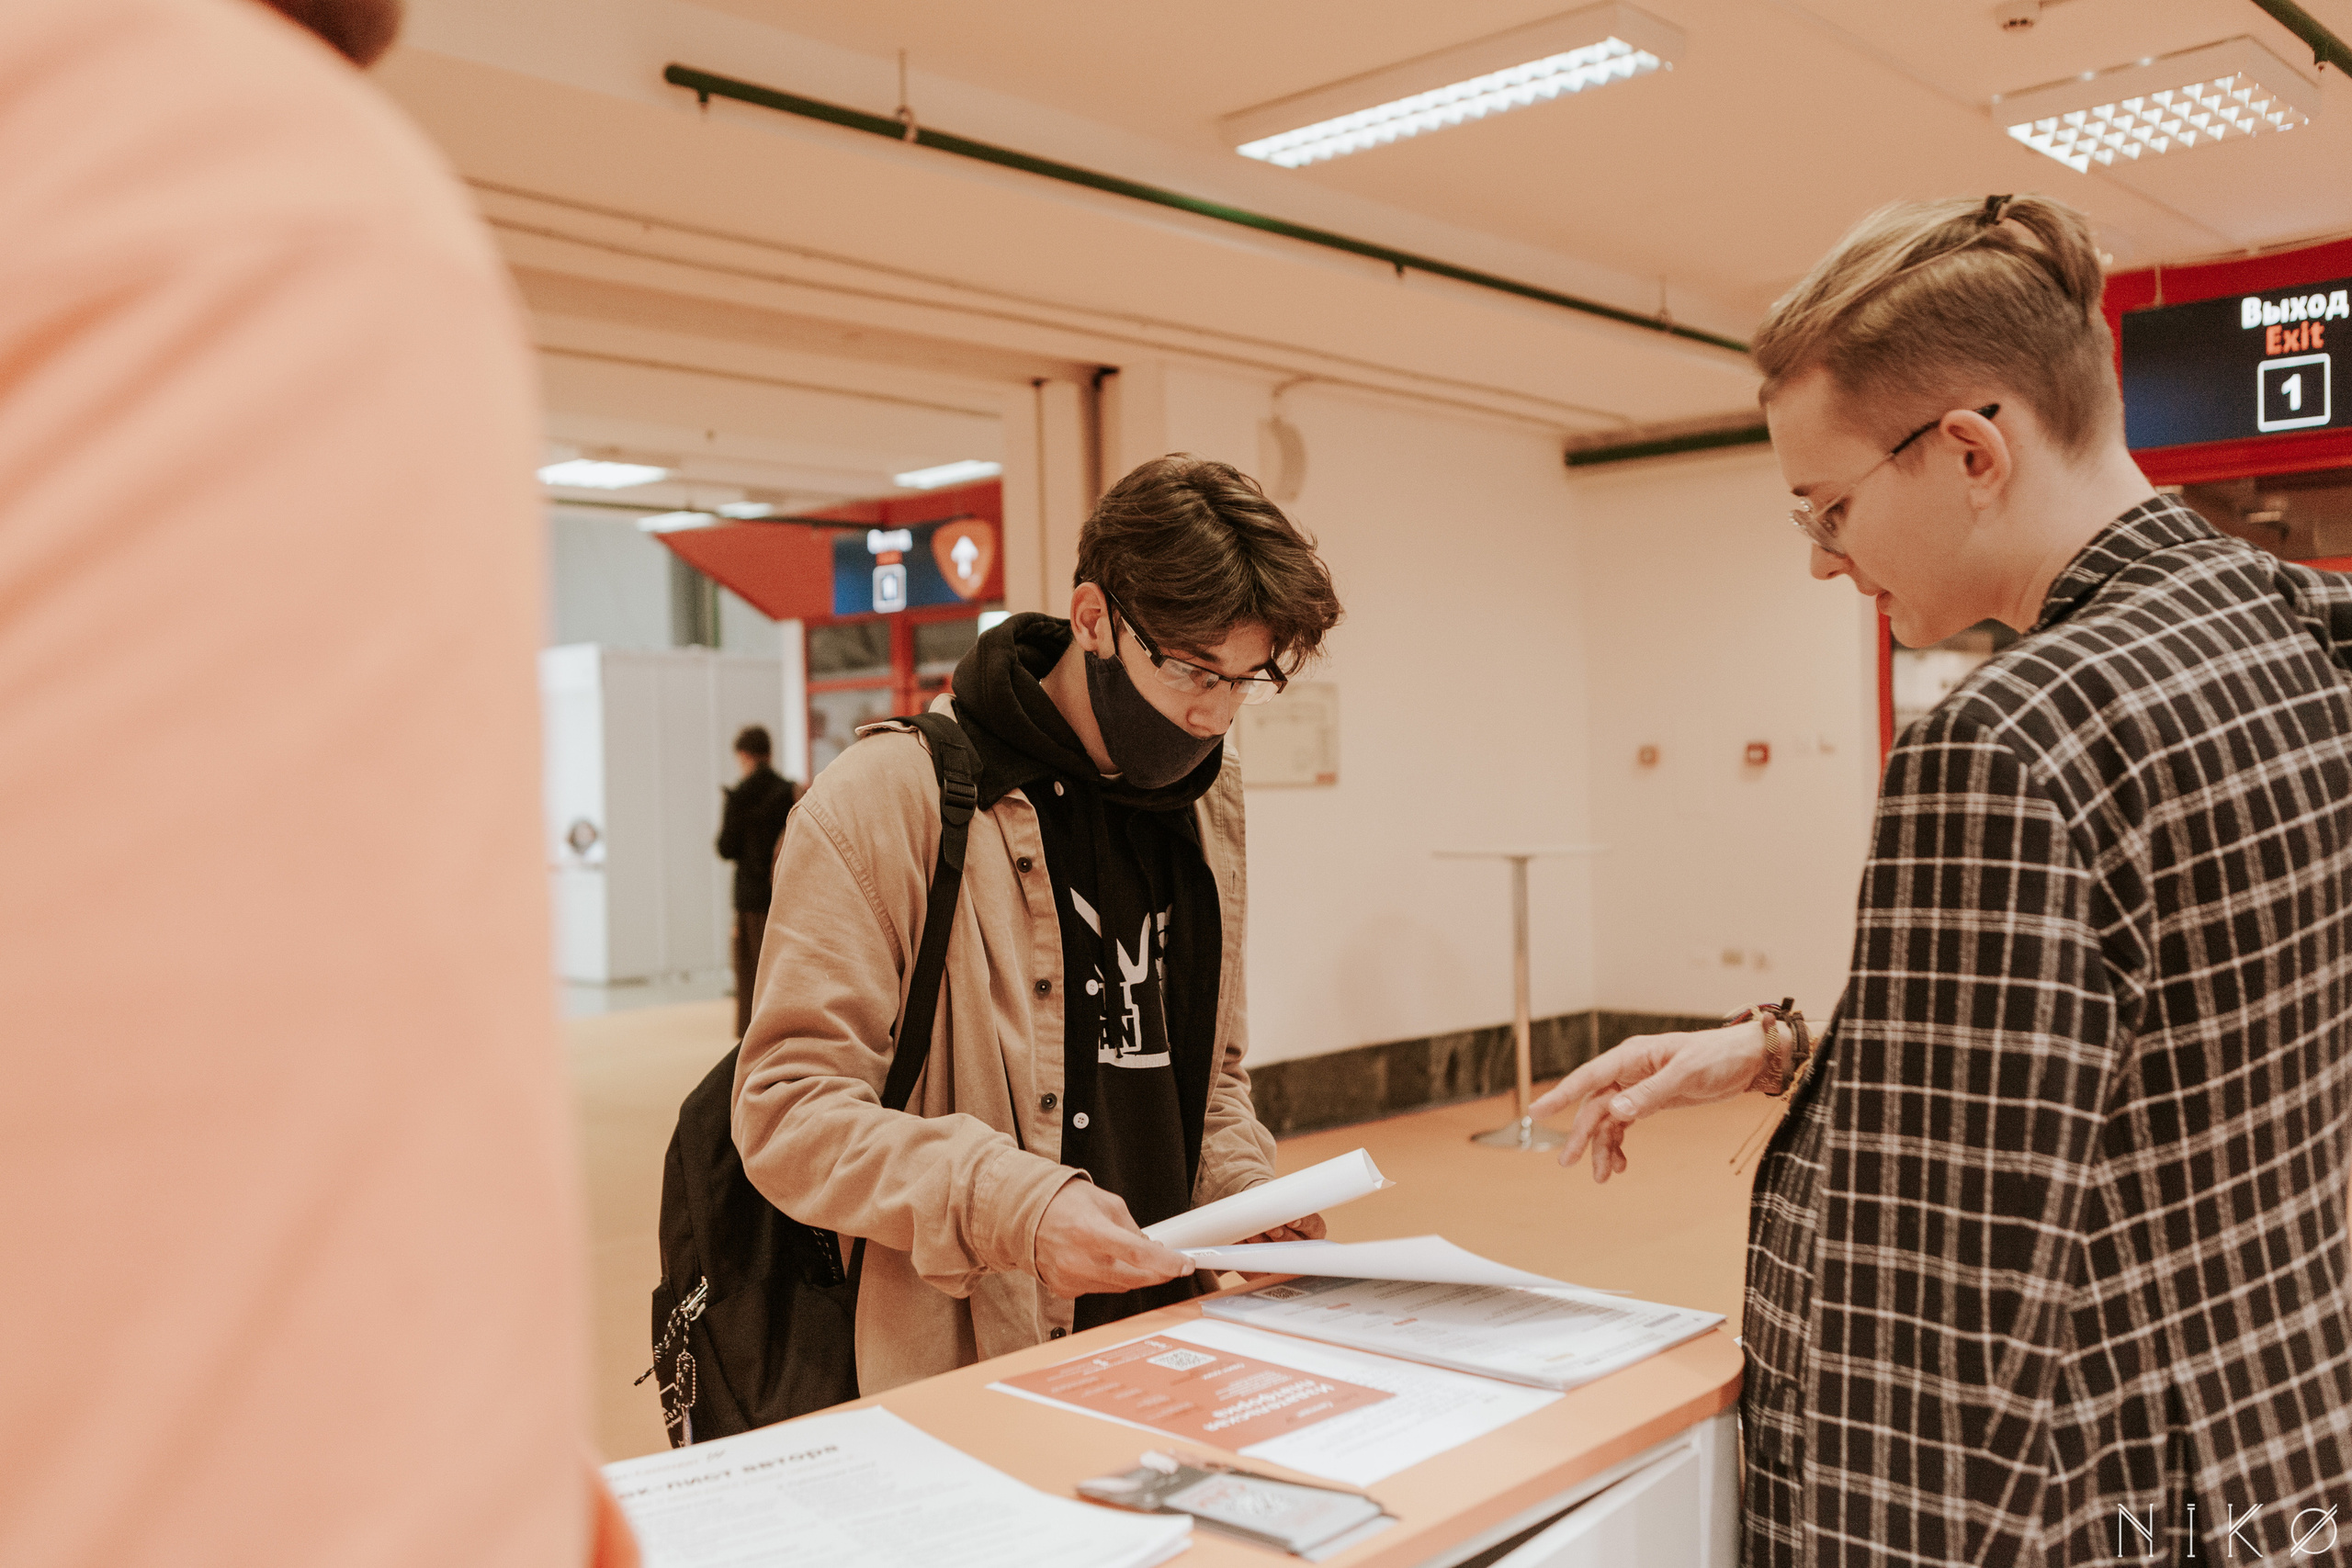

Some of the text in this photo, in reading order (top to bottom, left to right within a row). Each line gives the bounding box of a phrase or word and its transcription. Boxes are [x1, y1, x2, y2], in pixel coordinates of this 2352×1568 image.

[2241, 289, 2350, 330] Выход
[2265, 321, 2325, 356] Exit
[2280, 373, 2302, 412] 1
